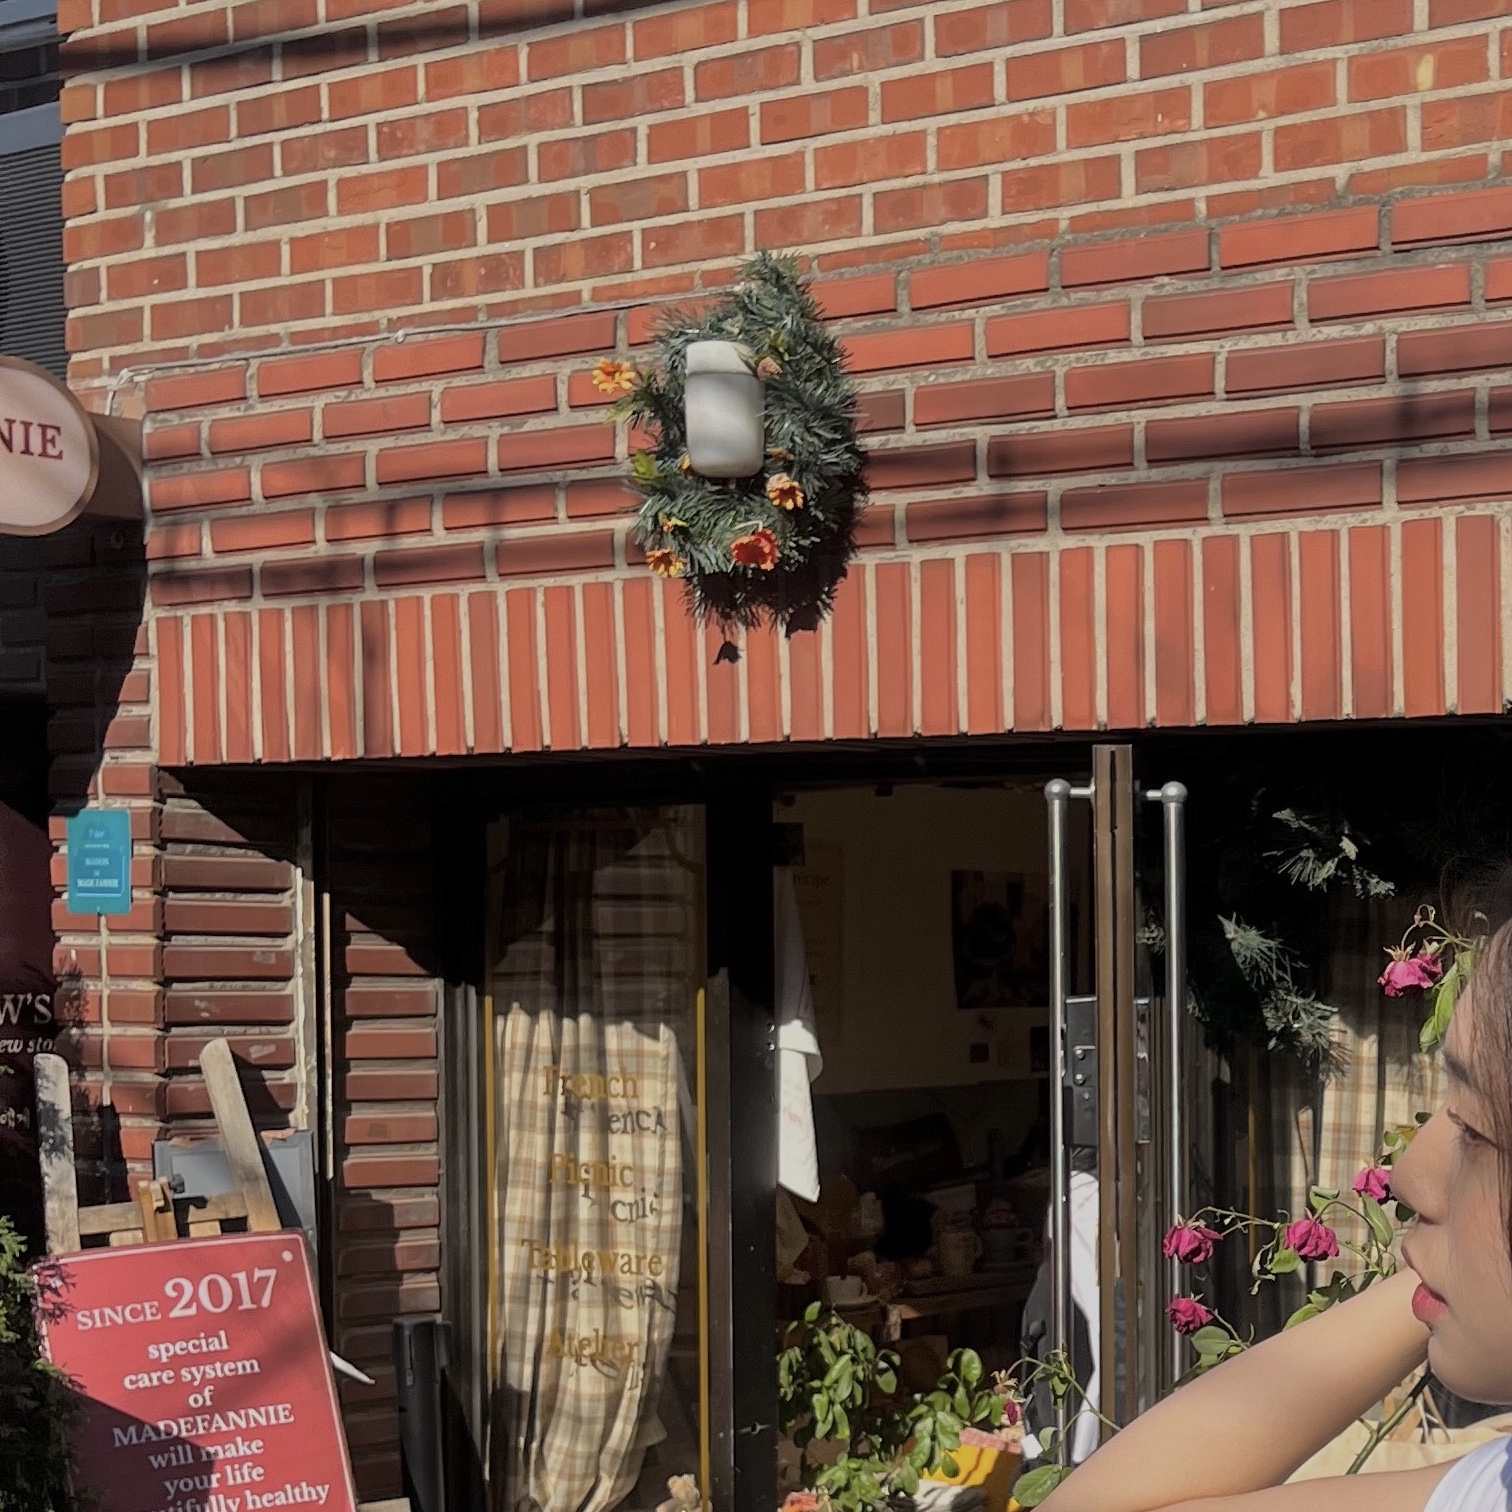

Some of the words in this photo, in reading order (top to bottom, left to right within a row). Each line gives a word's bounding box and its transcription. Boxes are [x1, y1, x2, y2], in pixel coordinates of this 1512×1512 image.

[542, 1065, 639, 1099] French
[550, 1154, 633, 1188] Picnic
[522, 1238, 663, 1276] Tableware
[76, 1301, 162, 1330] SINCE
[164, 1268, 278, 1318] 2017
[148, 1331, 229, 1363] special
[547, 1328, 640, 1362] Atelier
[123, 1369, 175, 1390] care
[180, 1357, 260, 1387] system
[188, 1386, 214, 1407] of
[113, 1404, 294, 1448] MADEFANNIE
[149, 1444, 193, 1470] will
[200, 1437, 264, 1462] make
[163, 1473, 222, 1501] your
[226, 1462, 264, 1486] life
